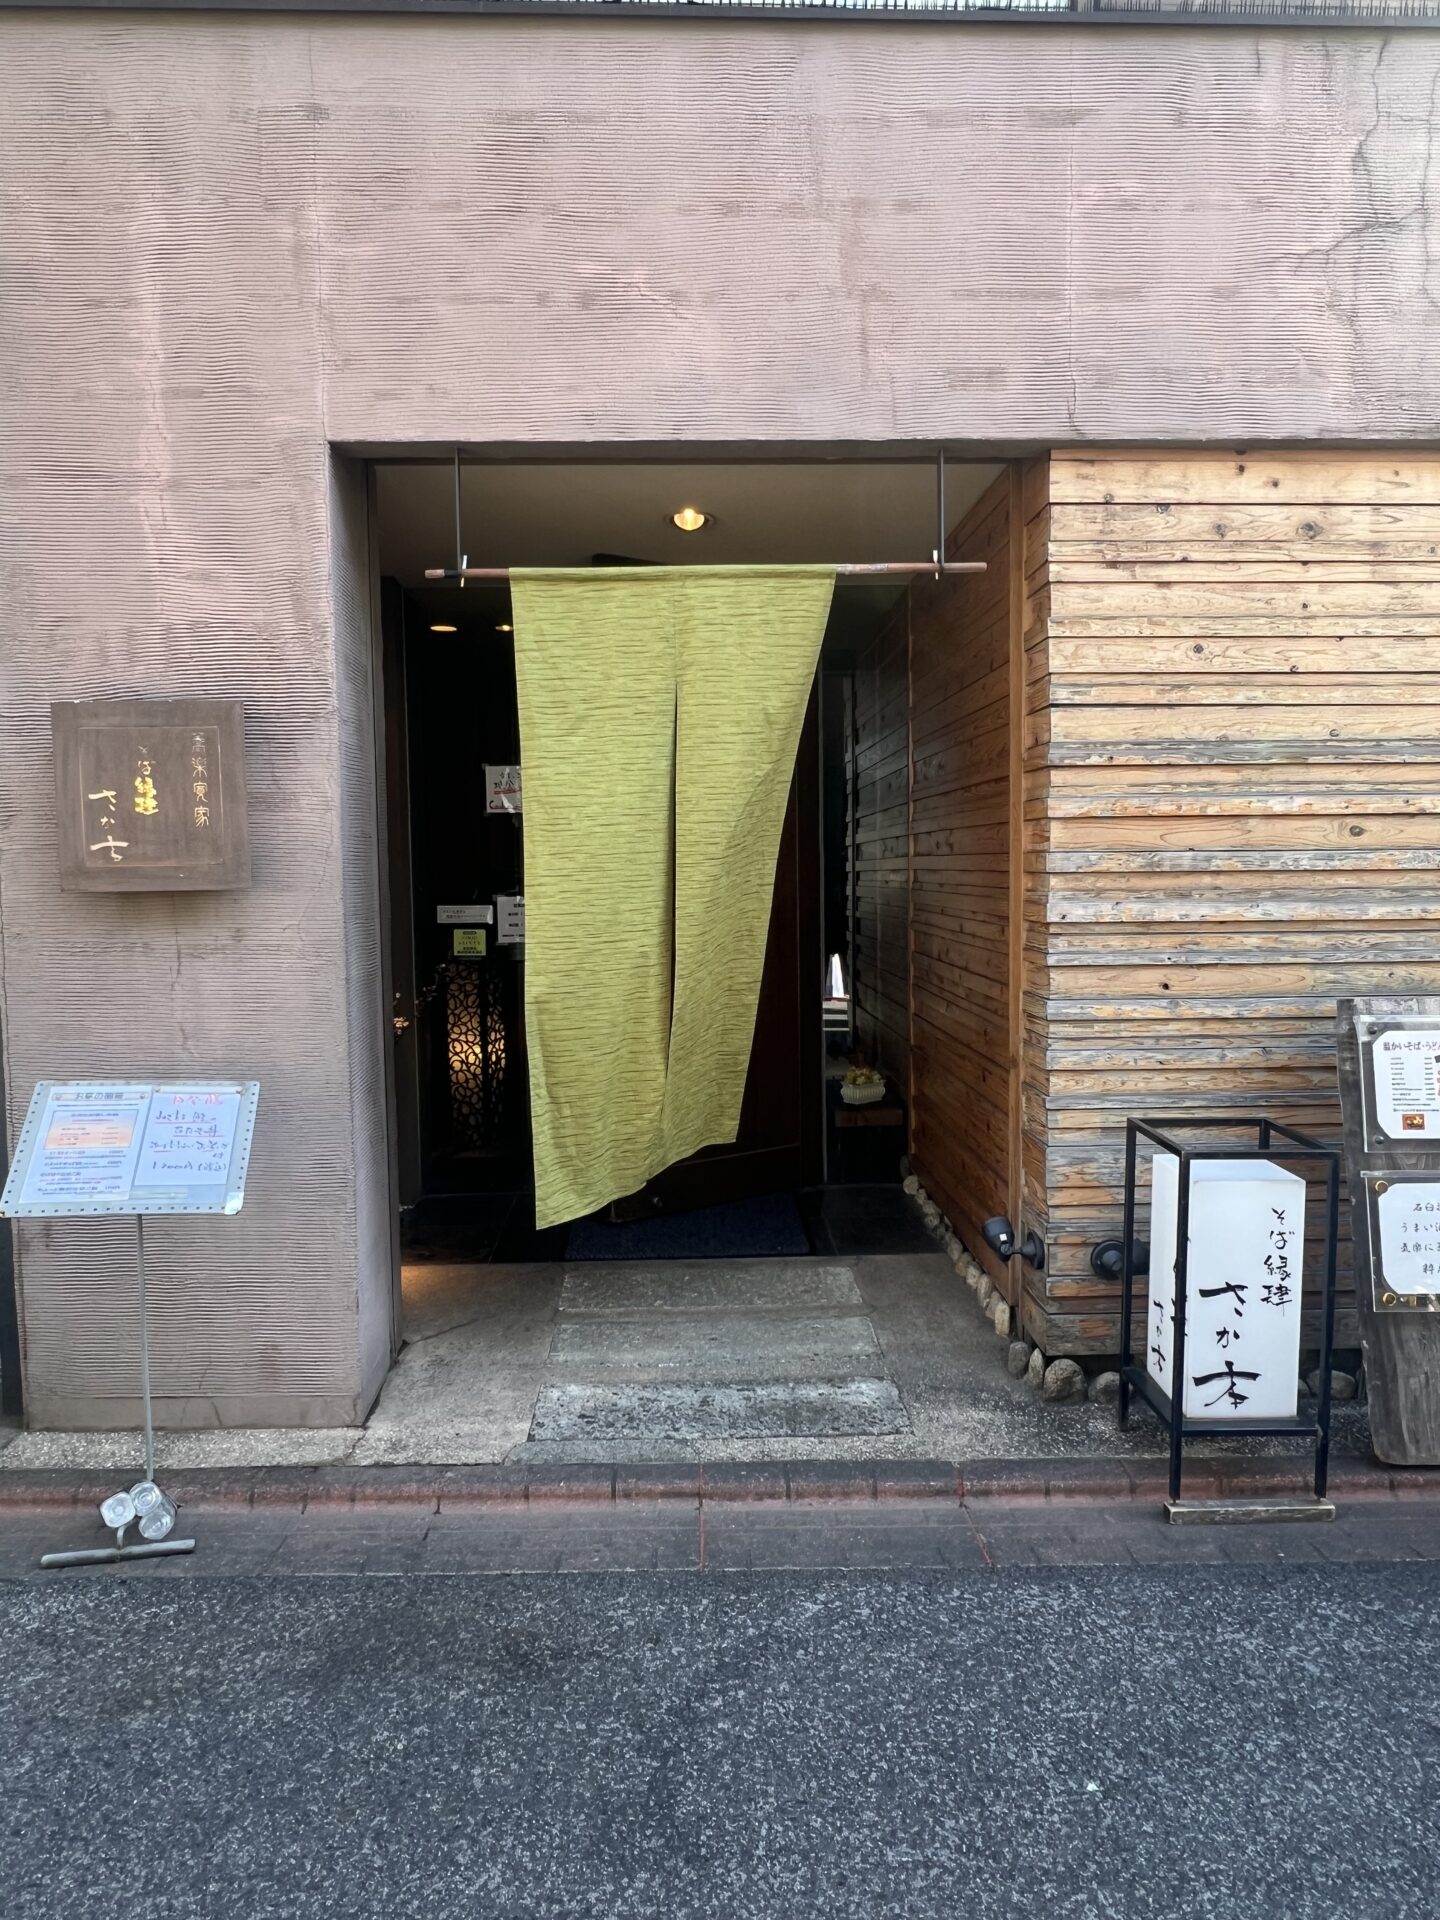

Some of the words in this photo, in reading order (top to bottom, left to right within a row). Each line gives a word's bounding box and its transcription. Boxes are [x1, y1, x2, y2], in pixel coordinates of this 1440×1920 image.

[1383, 1041, 1440, 1051] 温かいそば・うど
